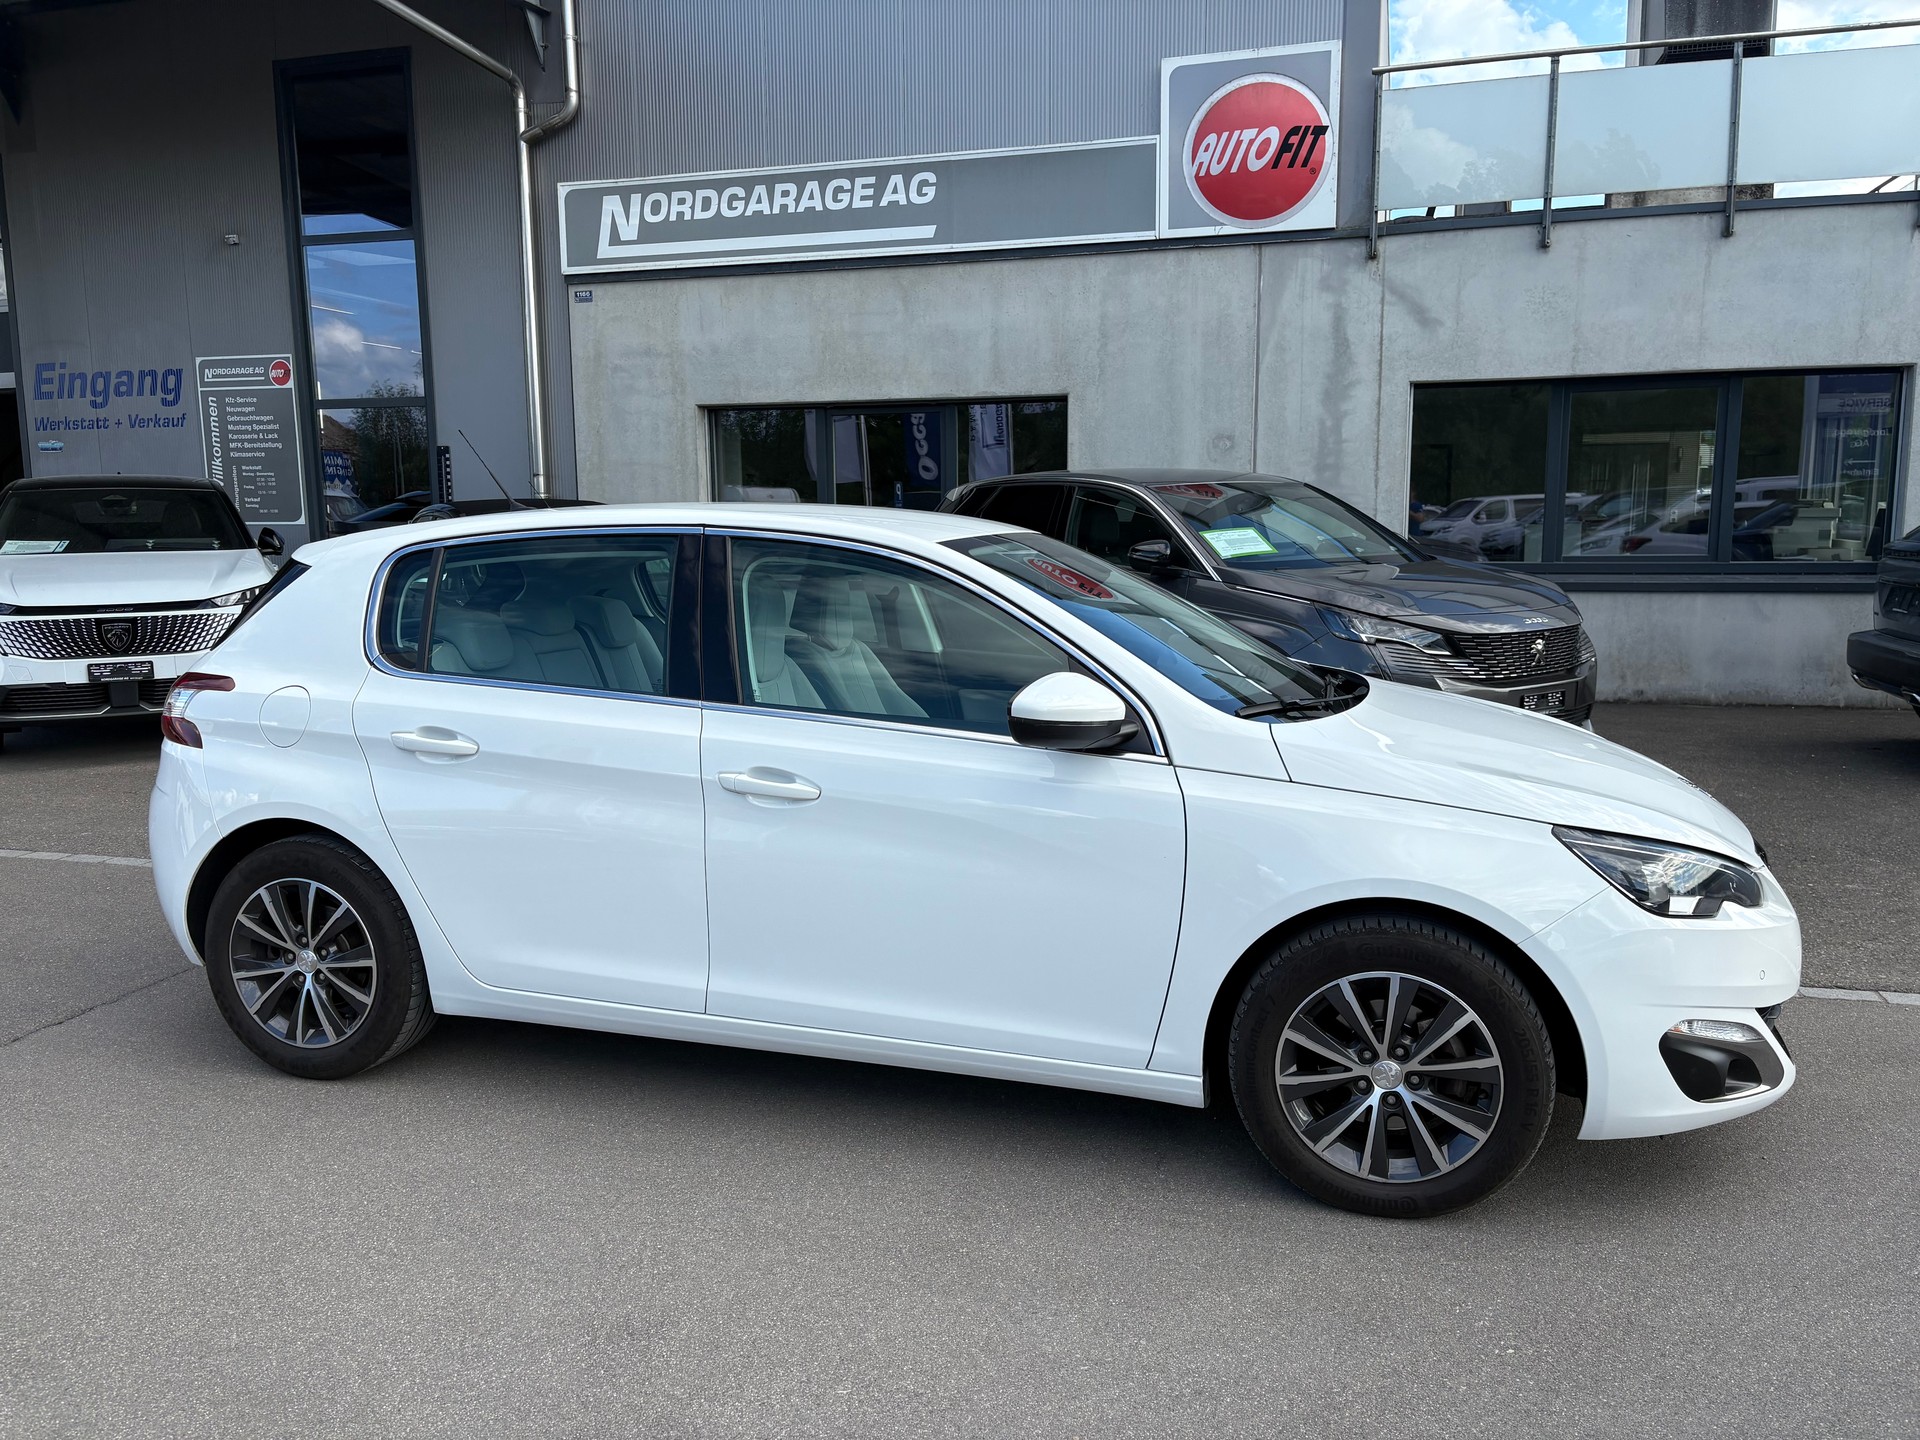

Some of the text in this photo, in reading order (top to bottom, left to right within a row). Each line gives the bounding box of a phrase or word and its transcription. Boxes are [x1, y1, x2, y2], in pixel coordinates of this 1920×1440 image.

[598, 171, 937, 256] NORDGARAGE AG
[33, 362, 183, 409] Eingang
[204, 366, 265, 380] NORDGARAGE AG
[34, 416, 110, 432] Werkstatt
[128, 412, 187, 429] Verkauf
[252, 423, 280, 431] Spezialist
[208, 397, 224, 486] illkommen
